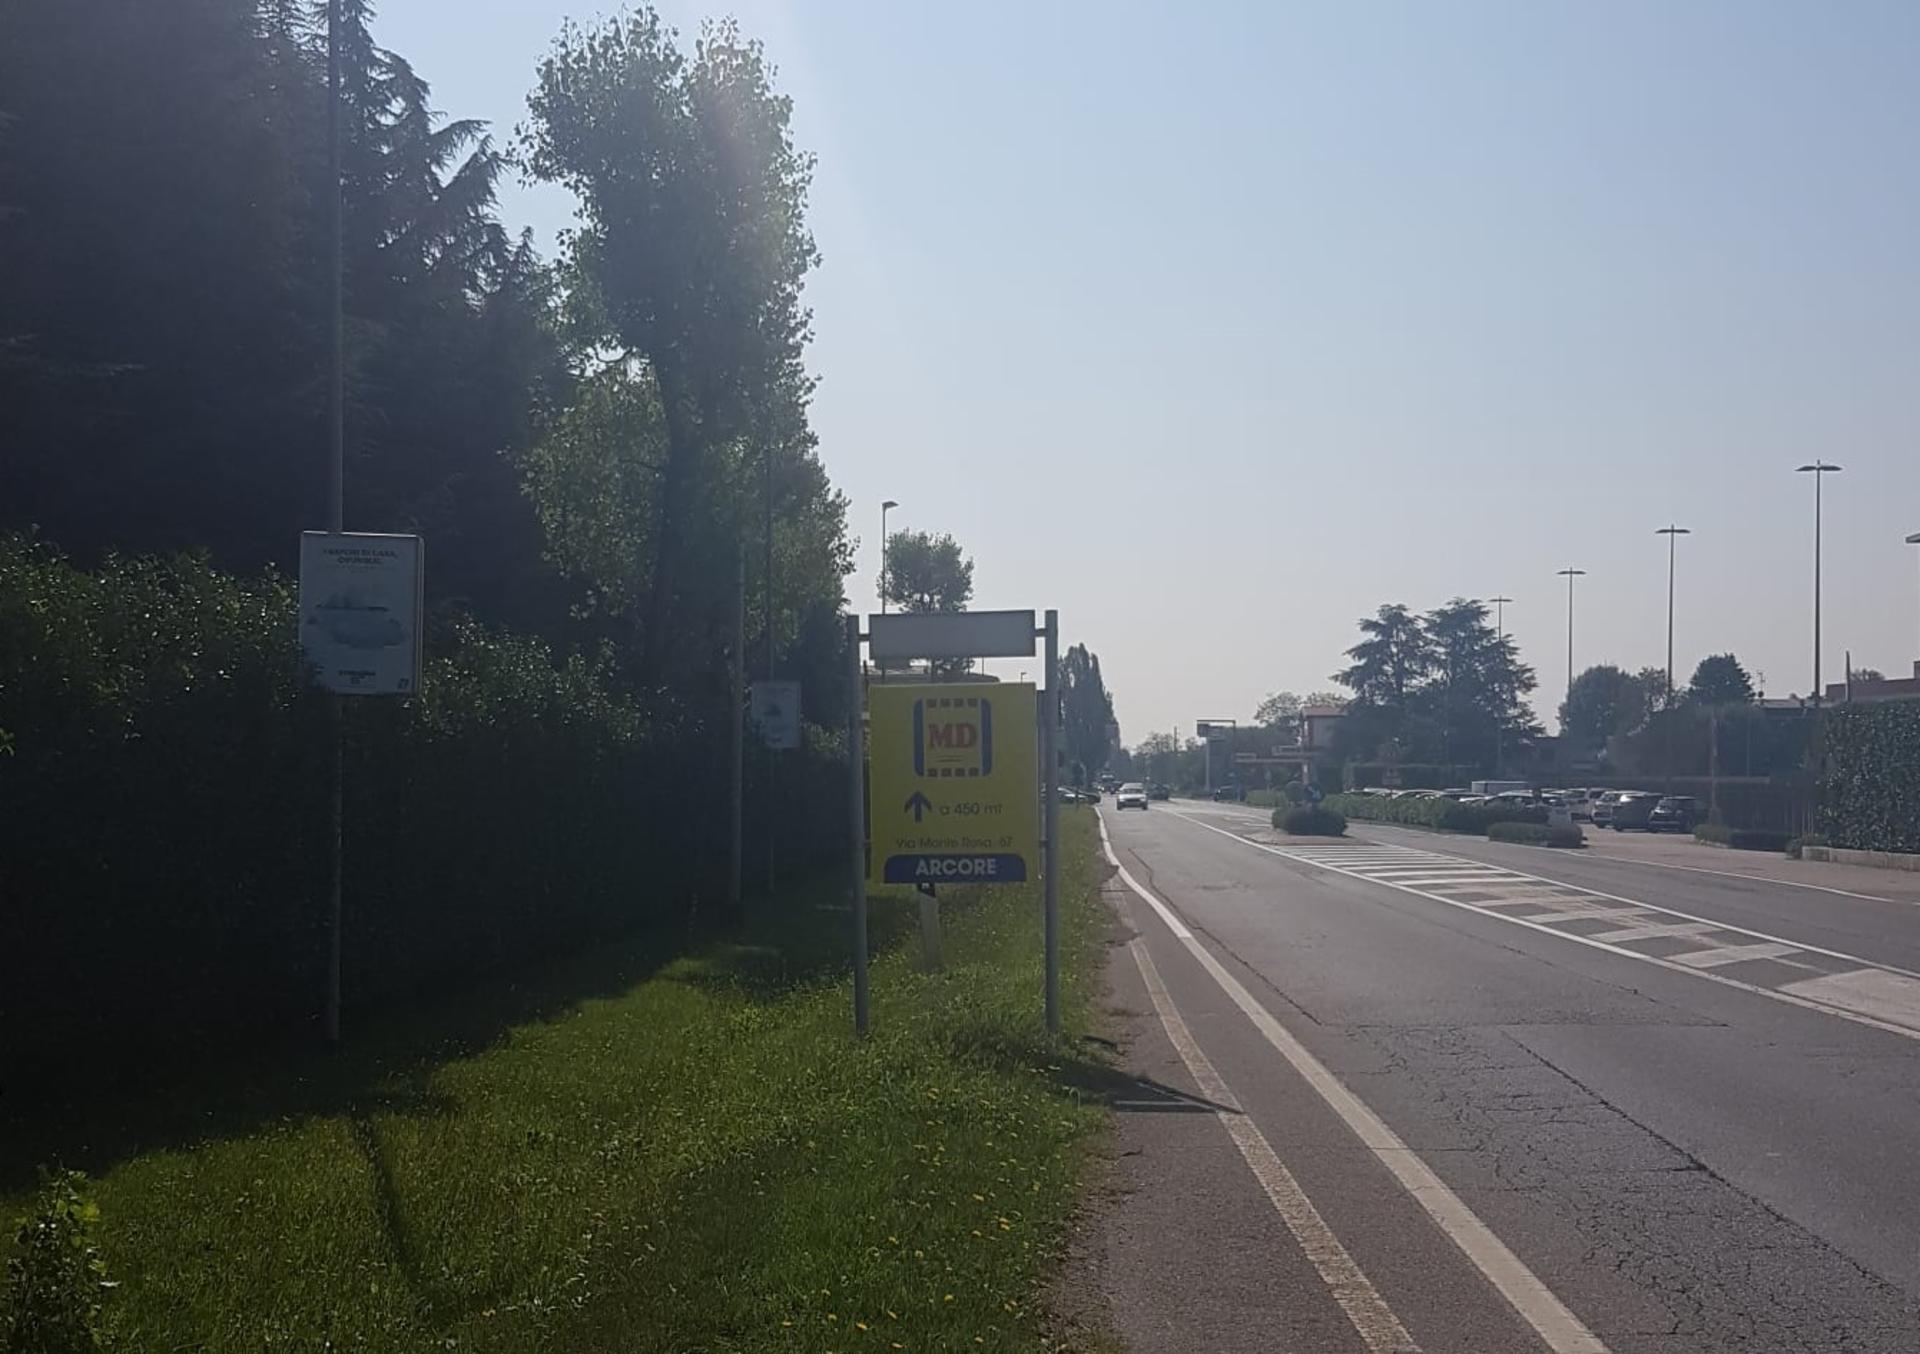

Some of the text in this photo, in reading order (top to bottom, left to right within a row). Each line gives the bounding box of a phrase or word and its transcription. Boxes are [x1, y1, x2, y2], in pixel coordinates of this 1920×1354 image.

[928, 723, 977, 748] MD
[940, 803, 1003, 815] a 450 mt
[896, 837, 916, 849] Via
[920, 836, 960, 848] Monte
[915, 858, 997, 876] ARCORE
